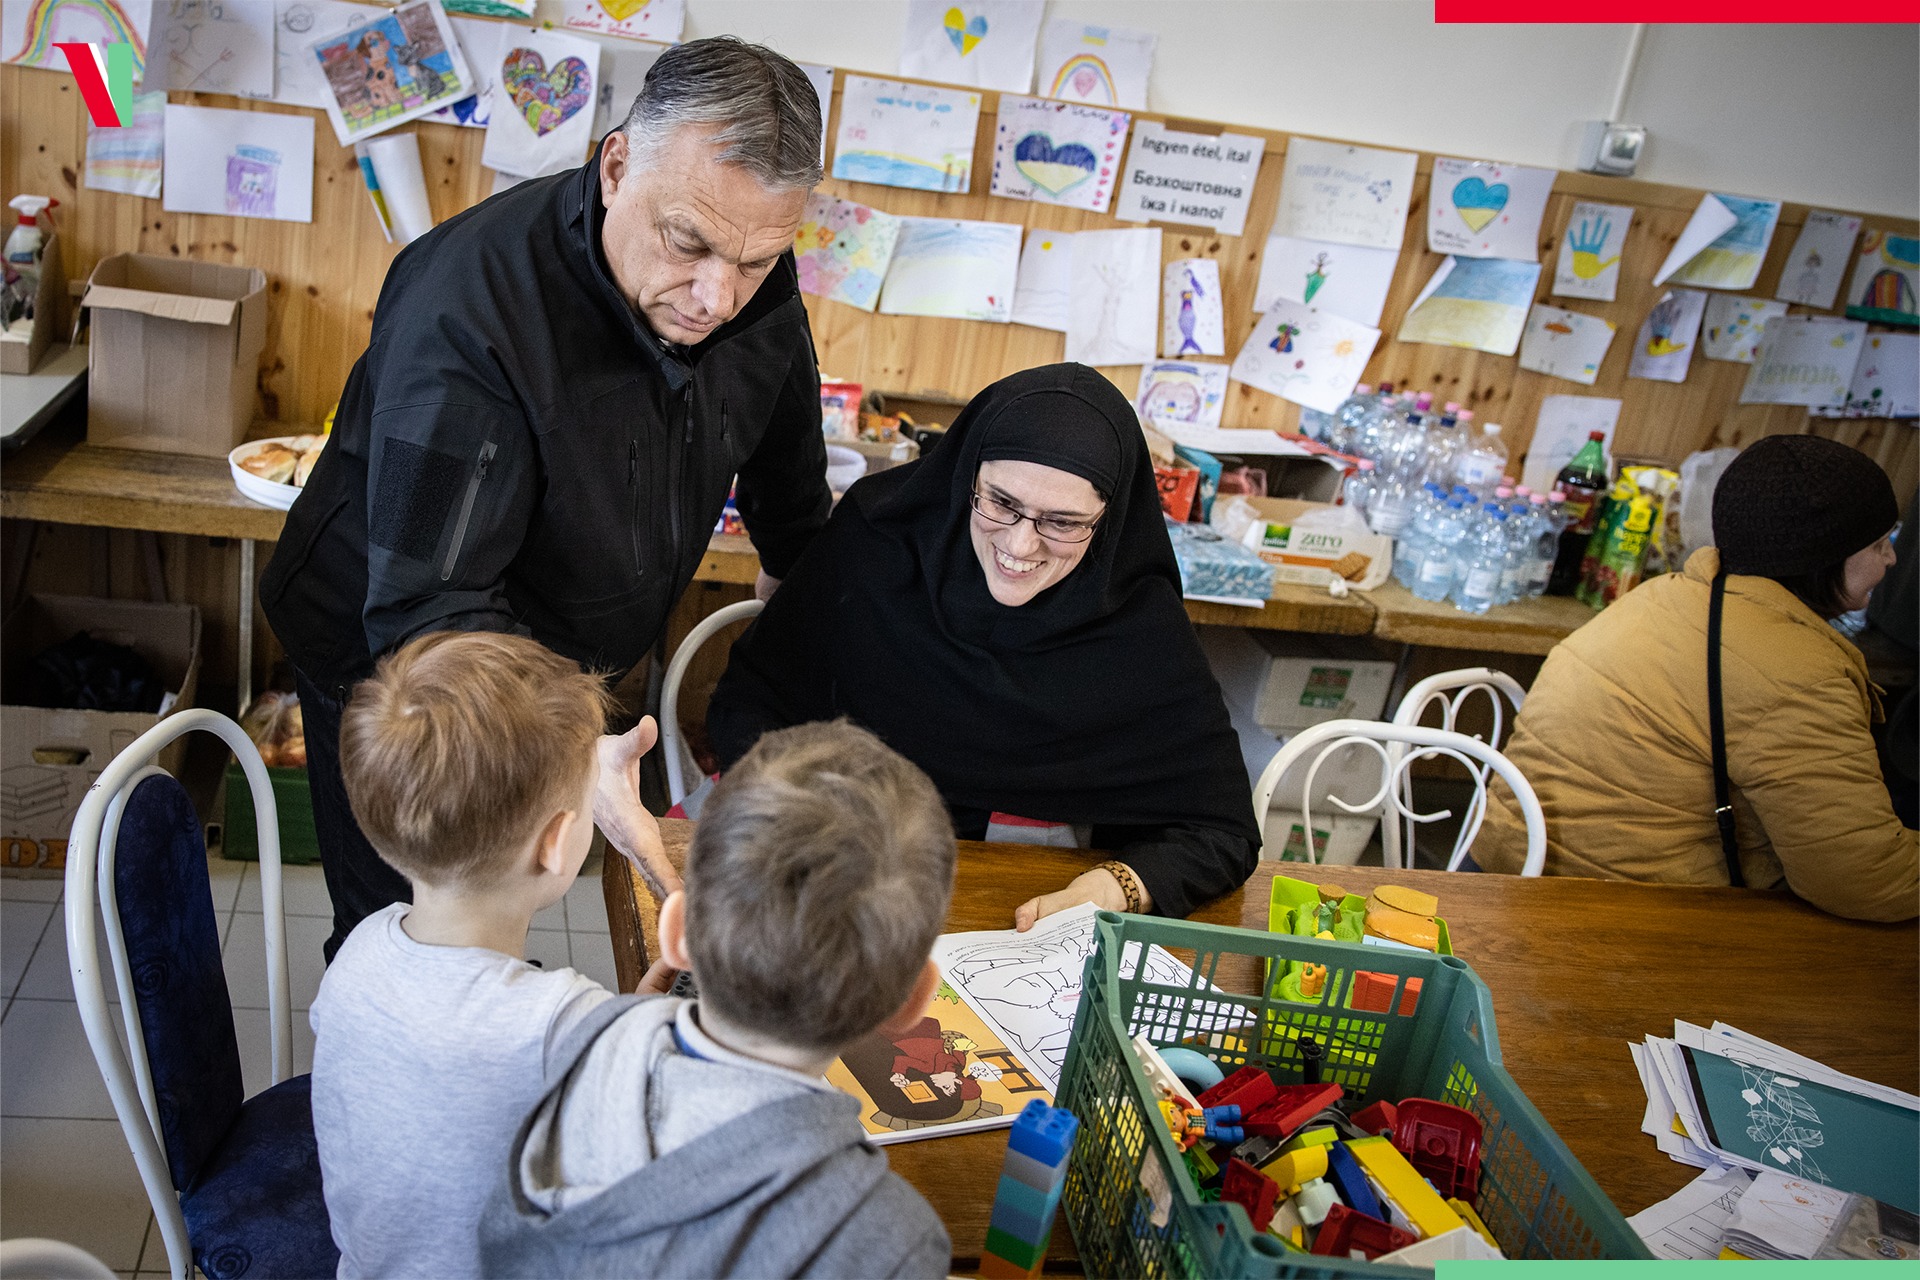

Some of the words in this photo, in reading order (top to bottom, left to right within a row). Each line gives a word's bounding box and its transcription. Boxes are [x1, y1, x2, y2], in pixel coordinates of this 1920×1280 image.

[1141, 136, 1189, 155] Ingyen
[1192, 142, 1223, 161] étel,
[1226, 147, 1251, 163] ital
[1132, 169, 1243, 199] Безкоштовна
[1140, 195, 1166, 212] їжа
[1179, 205, 1227, 220] напої
